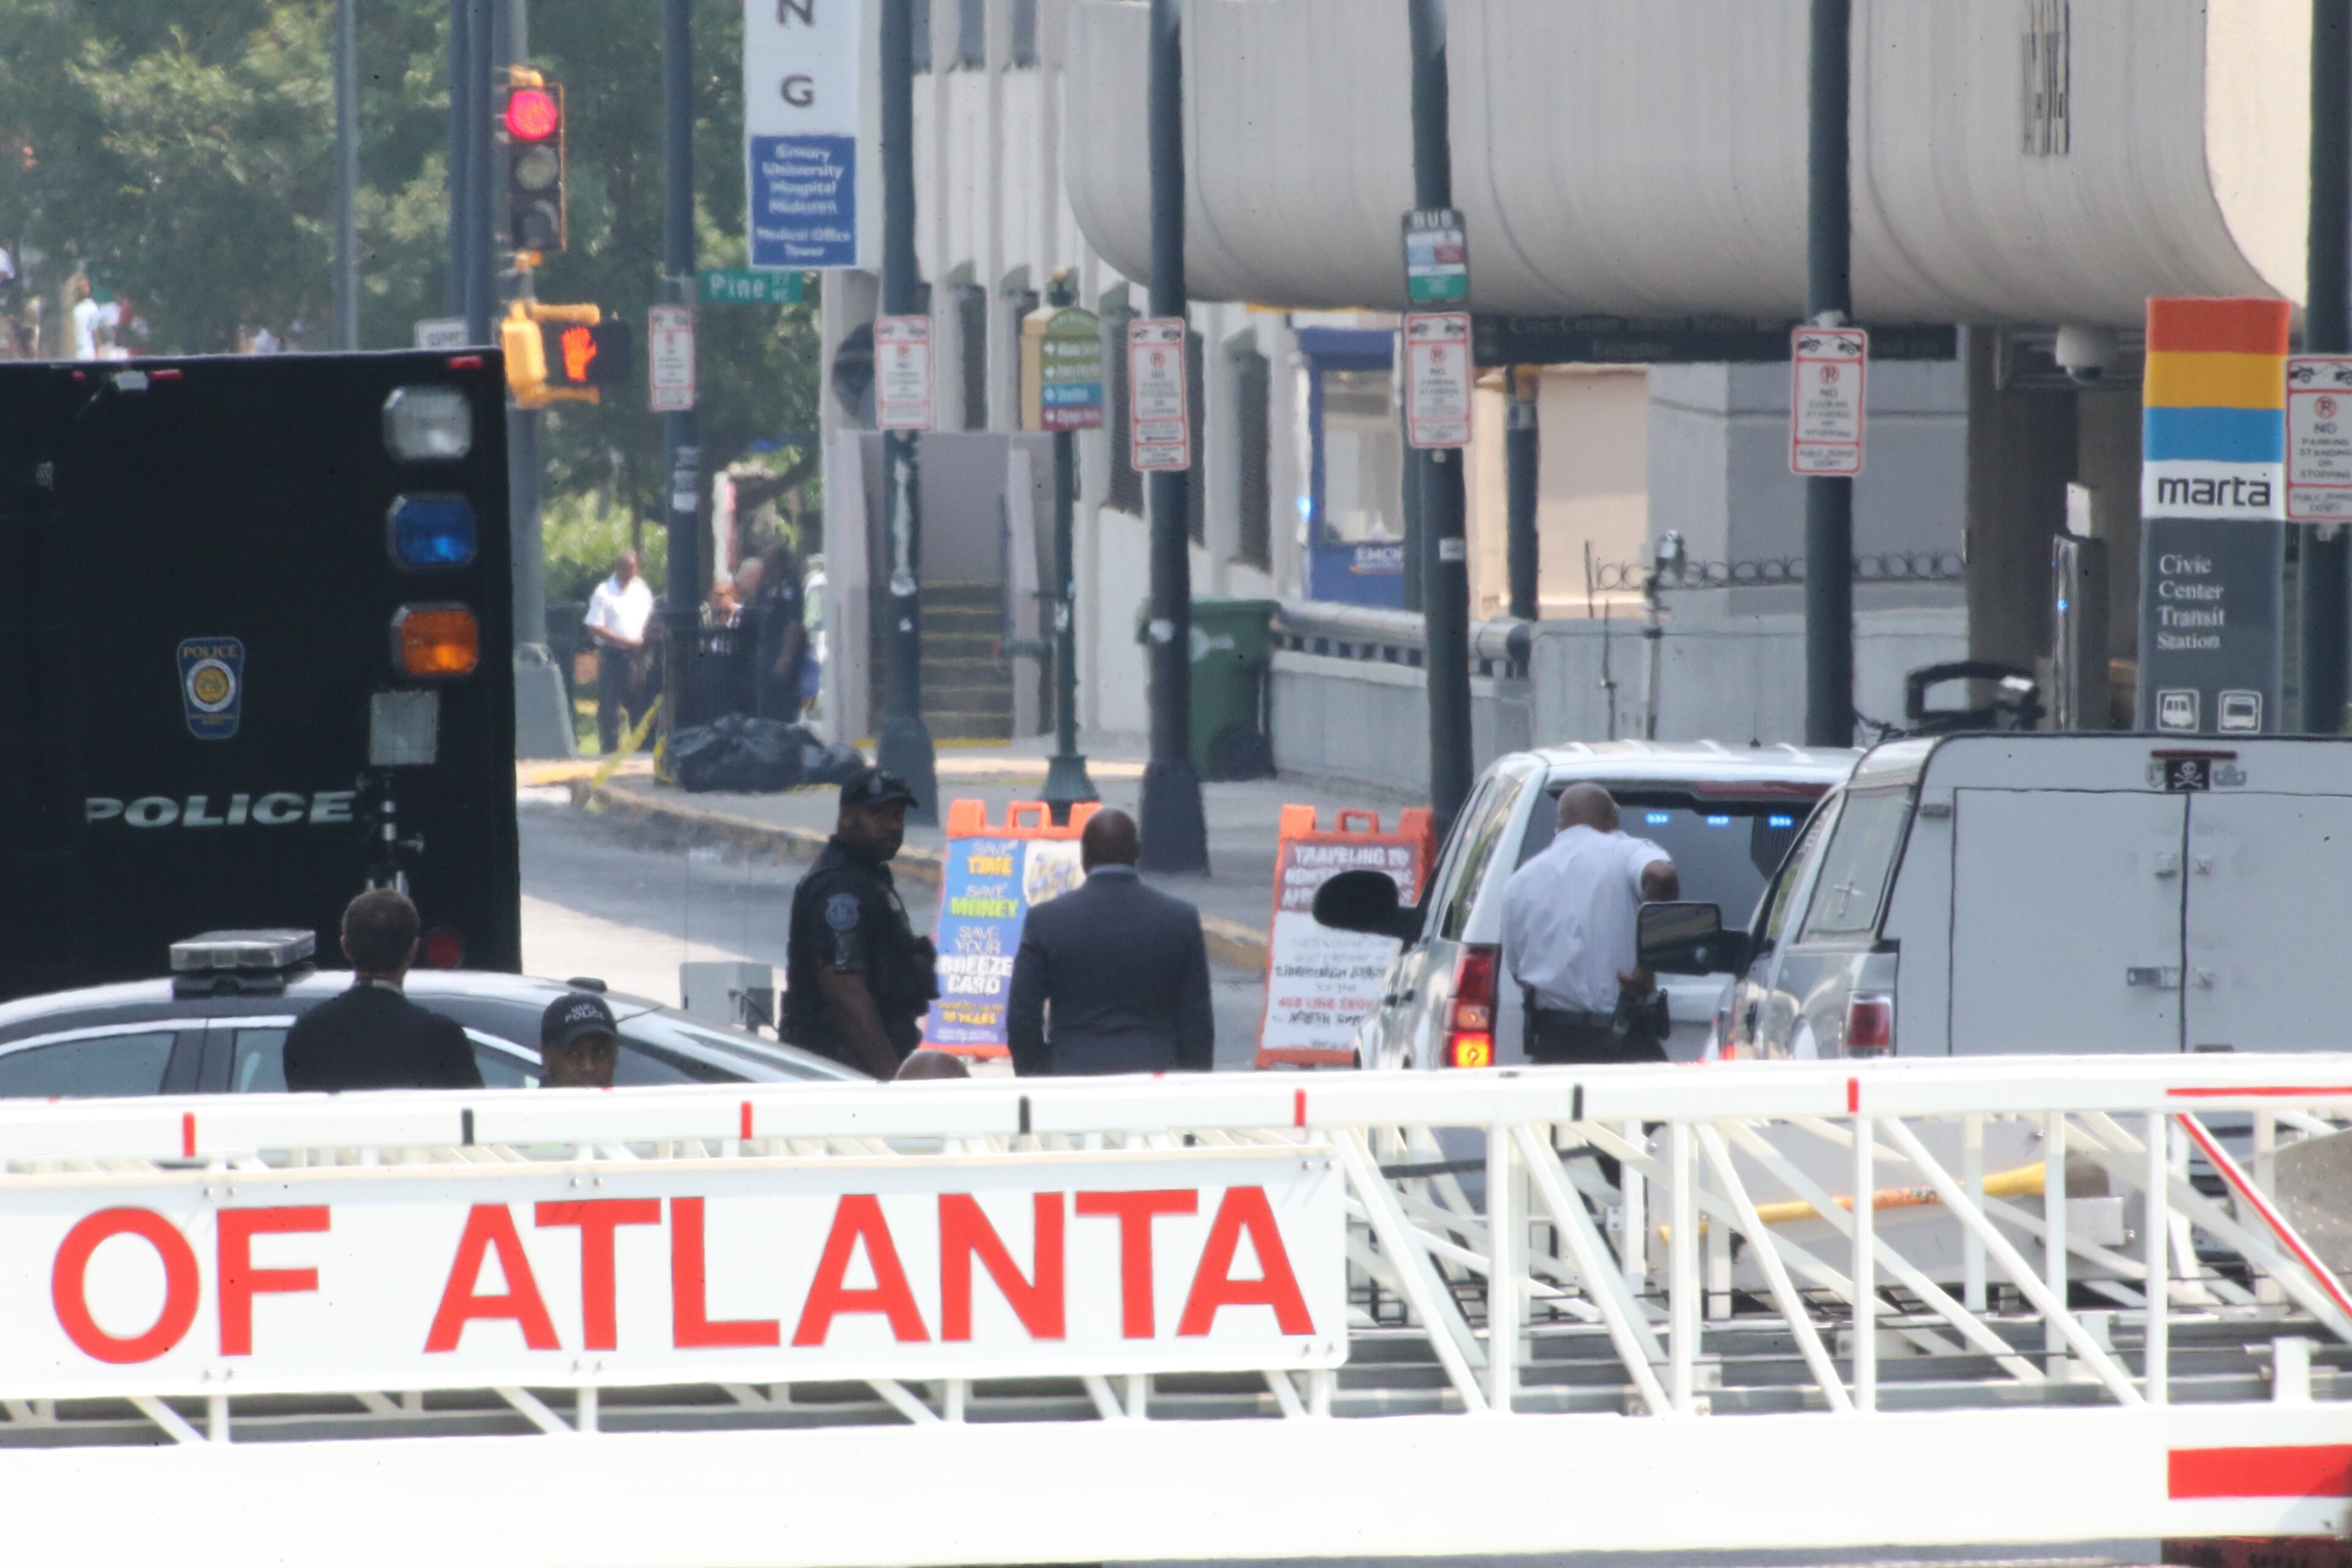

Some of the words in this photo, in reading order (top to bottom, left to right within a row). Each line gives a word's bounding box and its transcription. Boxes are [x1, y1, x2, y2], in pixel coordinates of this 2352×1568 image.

[780, 75, 813, 107] G
[762, 162, 844, 179] University
[709, 274, 764, 298] Pine
[1820, 388, 1838, 398] NO
[2313, 421, 2337, 434] NO
[2301, 437, 2350, 446] PARKING
[2157, 476, 2271, 507] marta
[2160, 554, 2212, 574] Civic
[2159, 580, 2225, 600] Center
[2157, 605, 2225, 627] Transit
[184, 644, 238, 658] POLICE
[2157, 633, 2220, 650] Station
[85, 791, 356, 827] POLICE
[972, 840, 1018, 856] SAVE
[1294, 846, 1385, 865] TRAVELING
[967, 856, 1012, 876] TIME
[967, 883, 1008, 899] SAVE
[951, 897, 1019, 918] MONEY
[959, 925, 999, 940] SAVE
[937, 955, 1013, 977] BREEZE
[947, 976, 1000, 995] CARD
[565, 1009, 605, 1023] POLICE
[51, 1205, 330, 1363] OF
[424, 1185, 1316, 1352] ATLANTA
